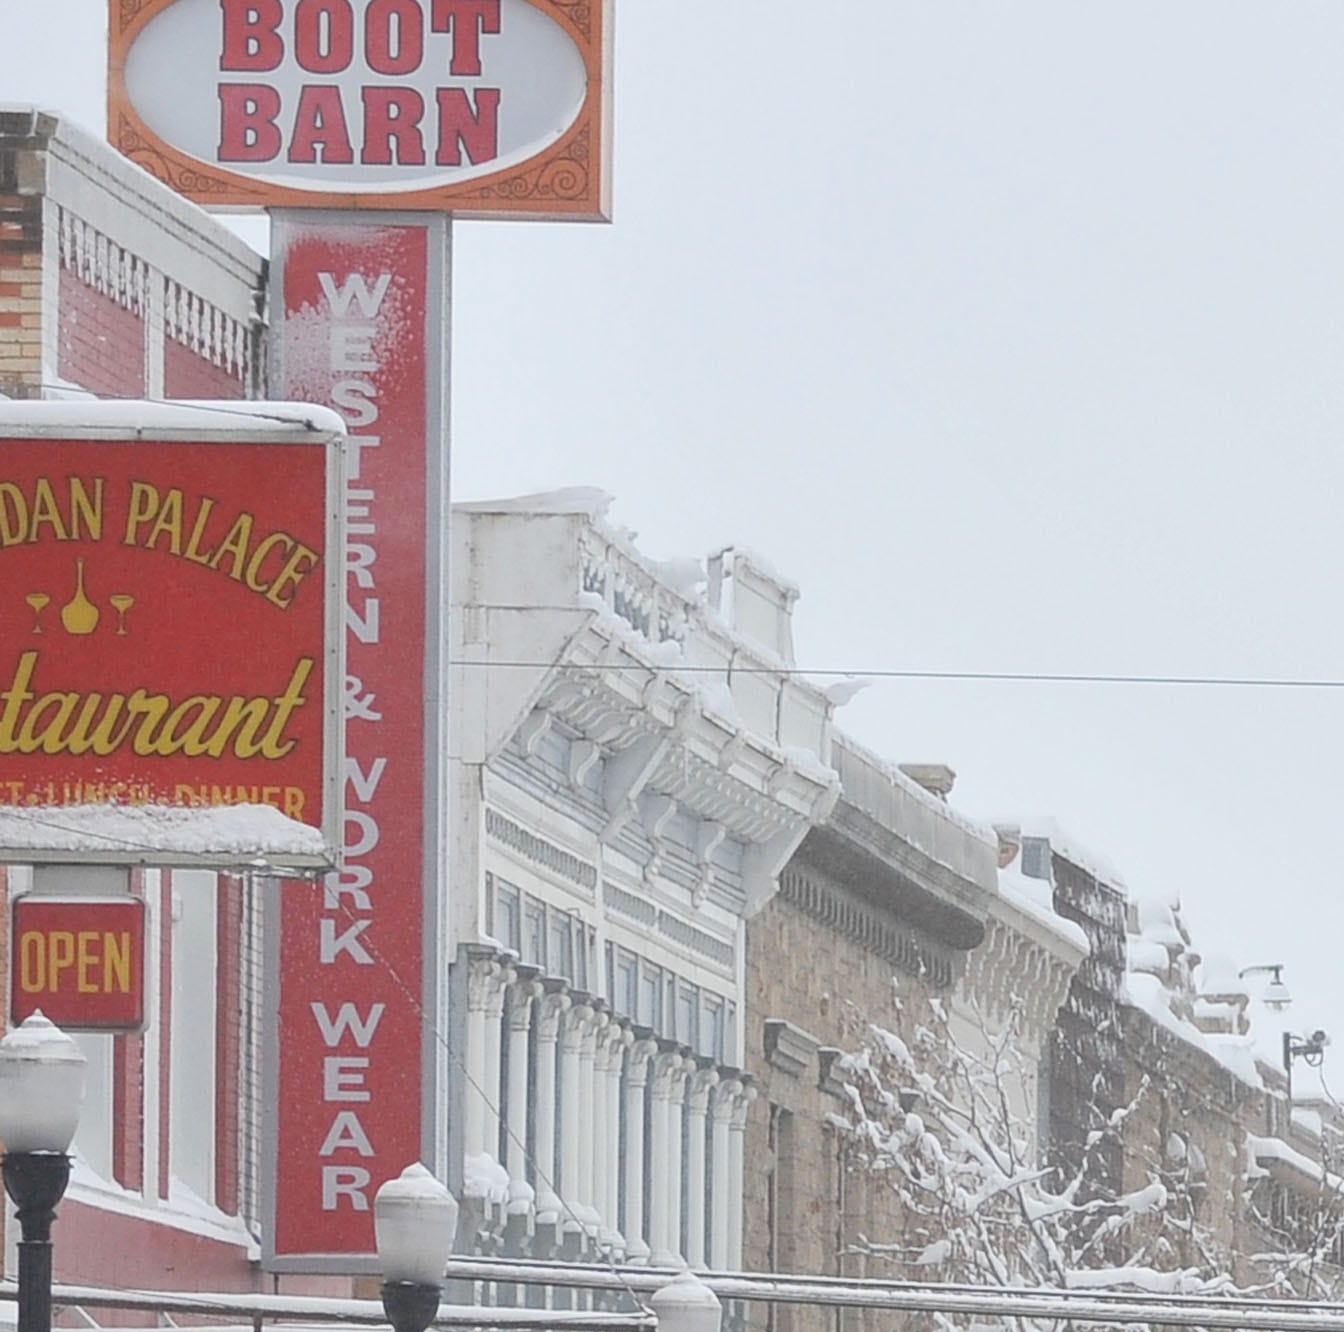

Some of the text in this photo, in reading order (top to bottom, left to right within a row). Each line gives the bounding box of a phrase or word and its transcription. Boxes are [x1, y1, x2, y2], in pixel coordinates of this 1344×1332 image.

[219, 0, 502, 77] BOOT
[216, 82, 502, 167] BARN
[0, 476, 320, 611] DAN PALACE
[19, 930, 132, 994] OPEN
[310, 1002, 386, 1212] WEAR
